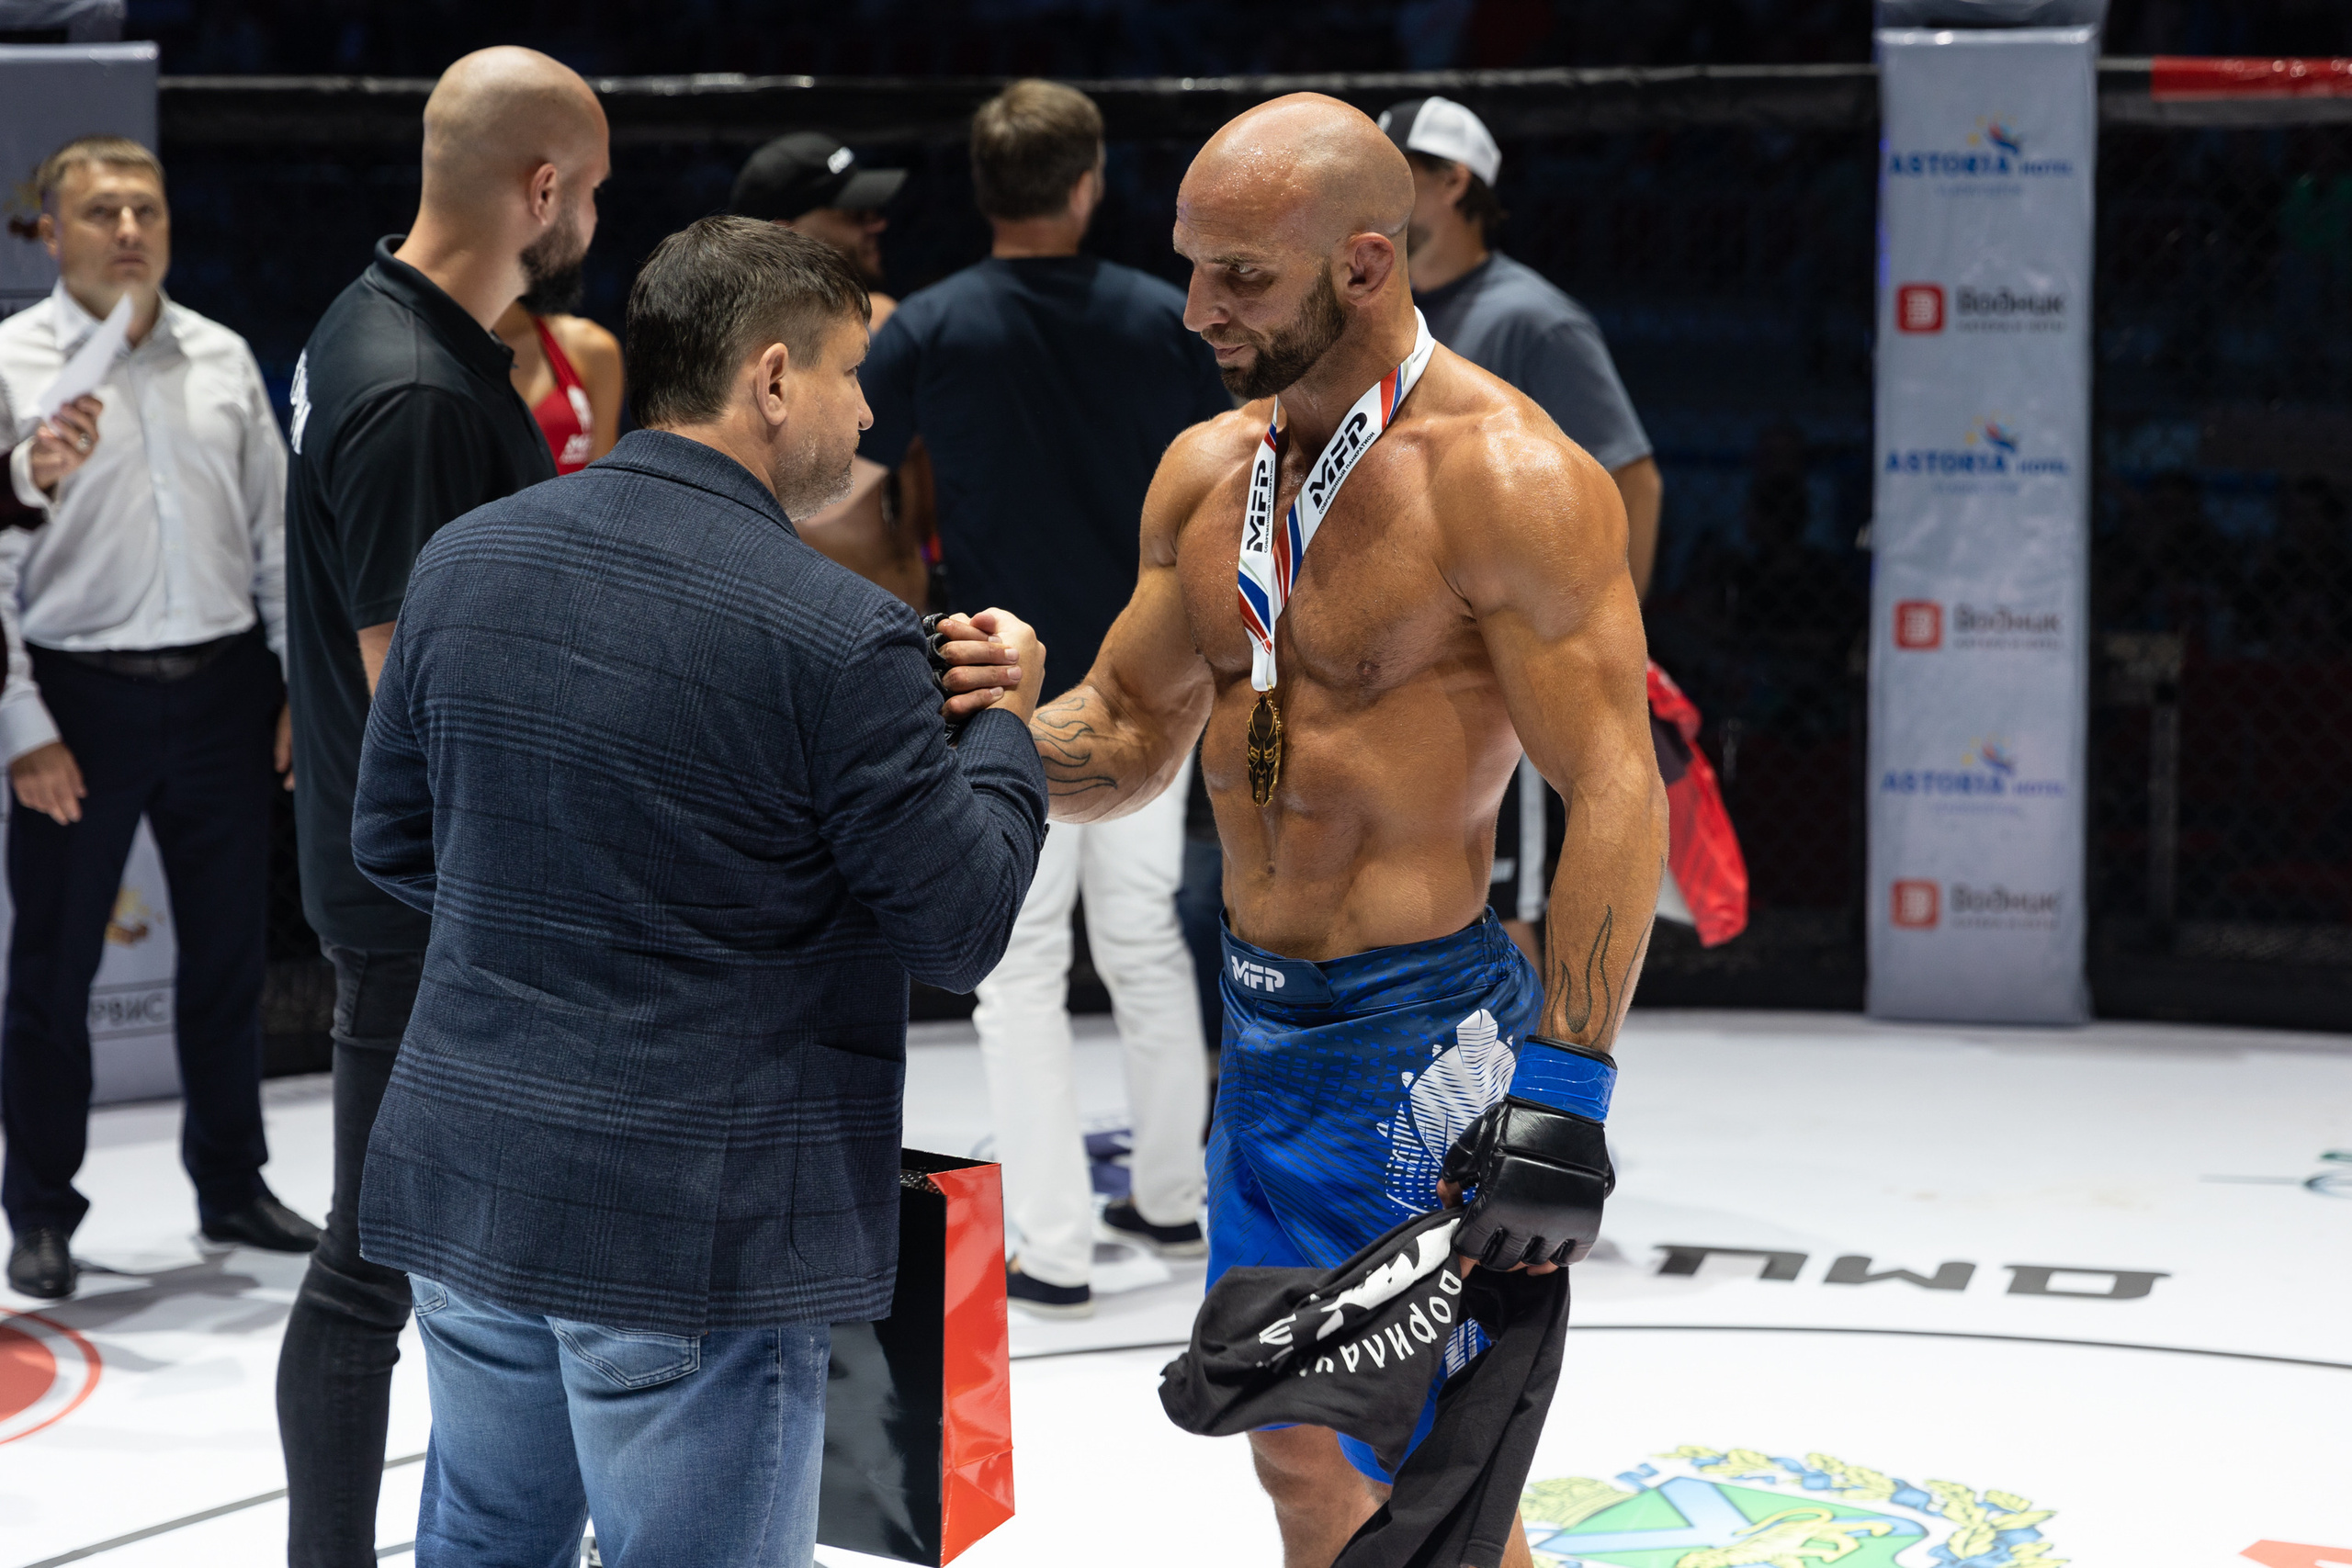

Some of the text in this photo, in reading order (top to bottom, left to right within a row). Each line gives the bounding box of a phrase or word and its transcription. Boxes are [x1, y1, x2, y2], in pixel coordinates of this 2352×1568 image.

[1247, 459, 1269, 553] MFP
[1308, 412, 1368, 509] MFP
[1231, 954, 1285, 992] MFP
